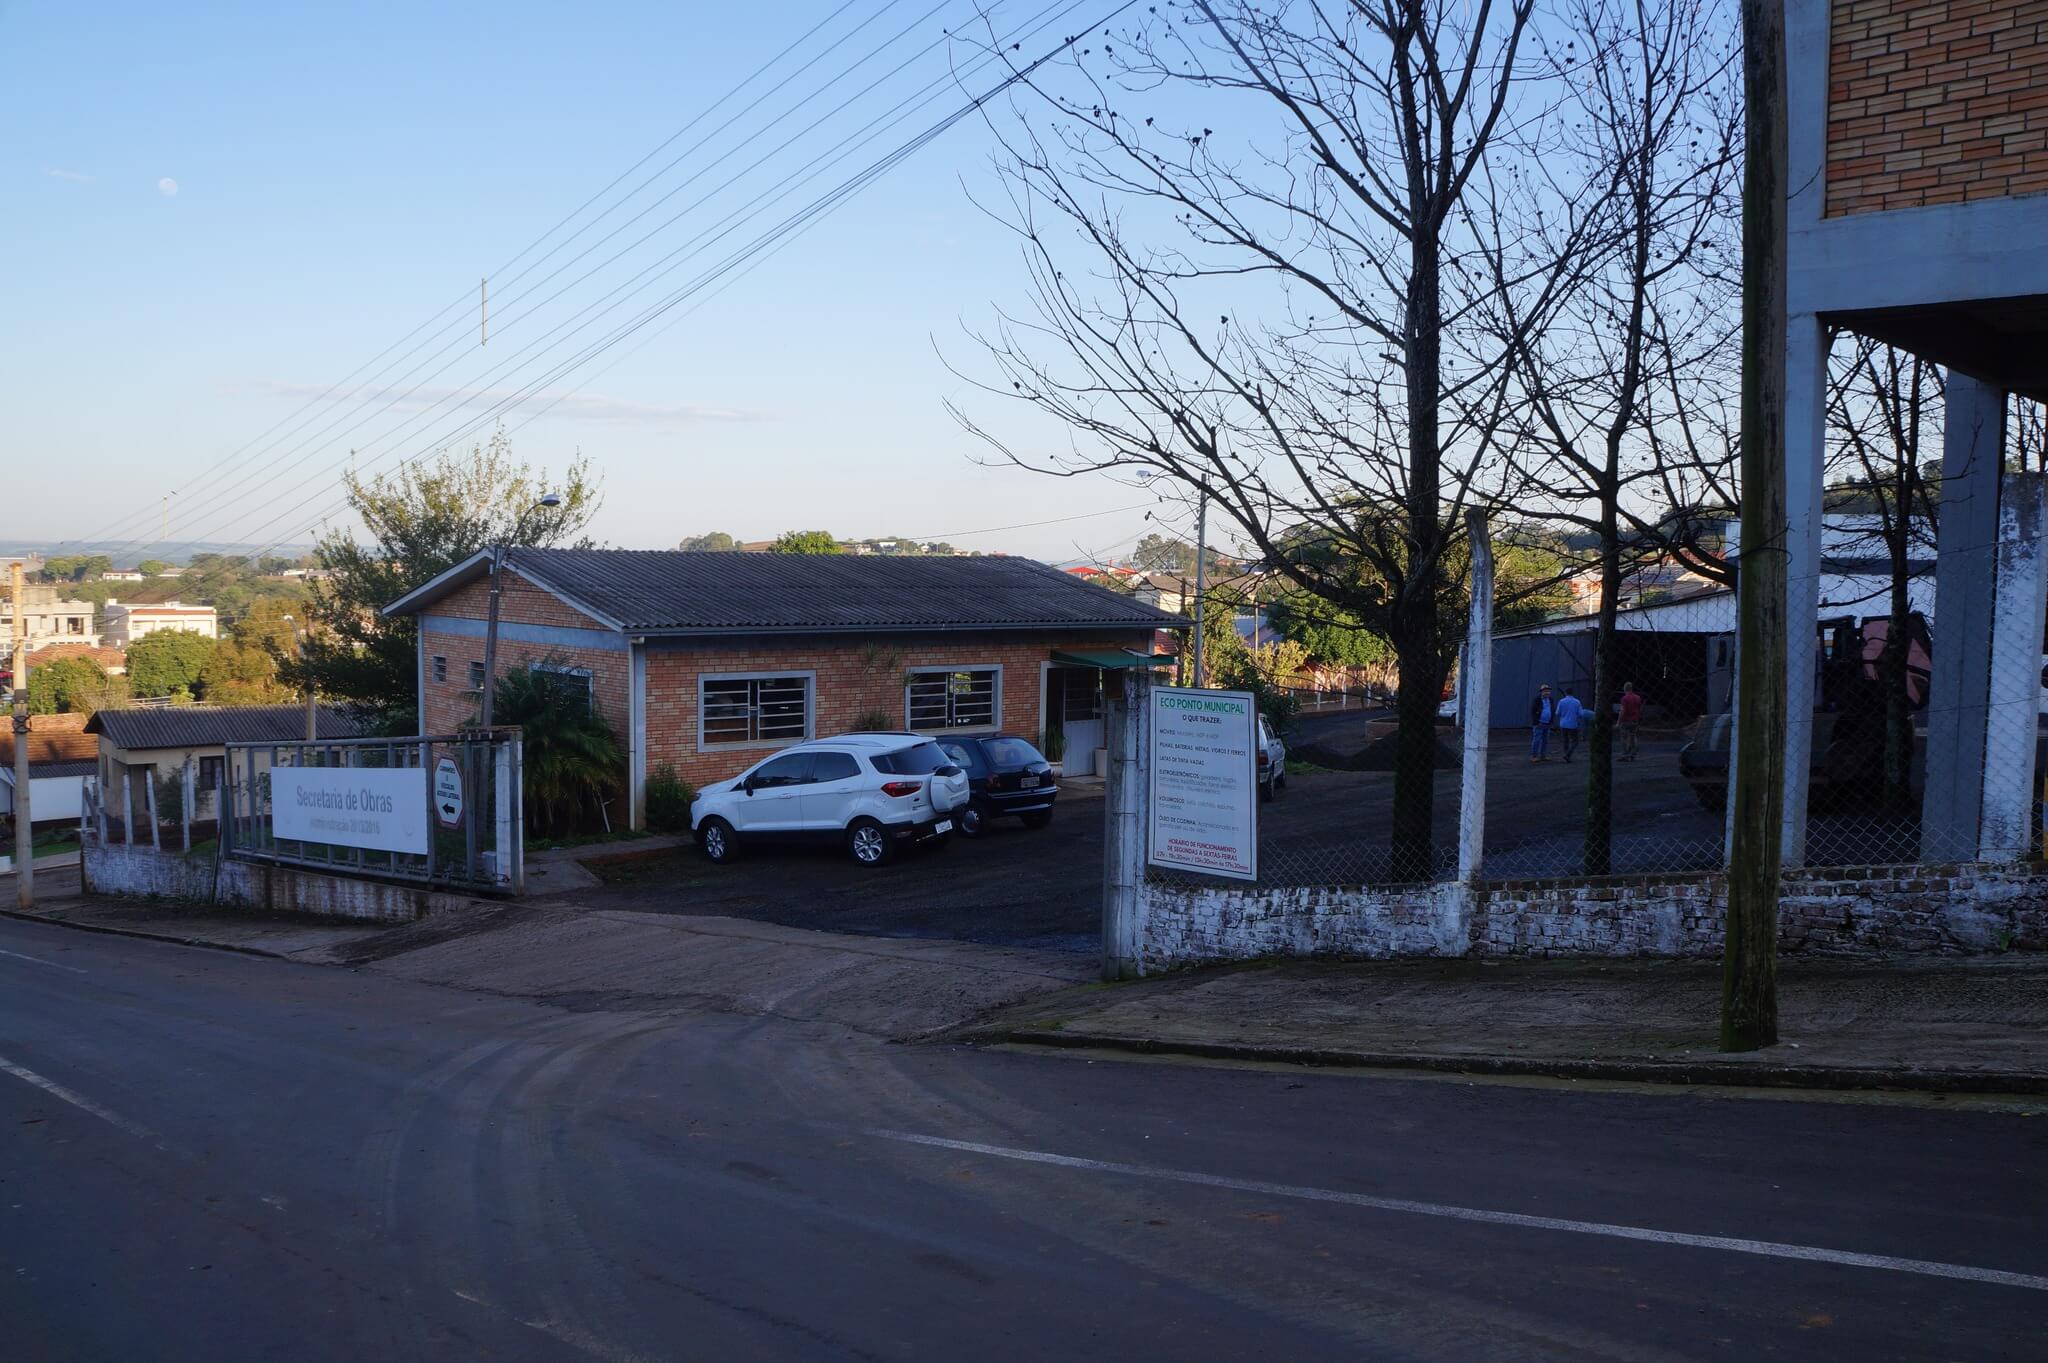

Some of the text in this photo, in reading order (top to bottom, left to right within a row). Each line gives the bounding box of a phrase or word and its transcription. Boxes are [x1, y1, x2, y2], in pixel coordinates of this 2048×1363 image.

[1161, 698, 1245, 714] ECO PONTO MUNICIPAL
[296, 785, 392, 813] Secretaria de Obras
[1175, 847, 1198, 856] SEGUNDAS
[1197, 842, 1237, 854] FUNCIONAMENTO
